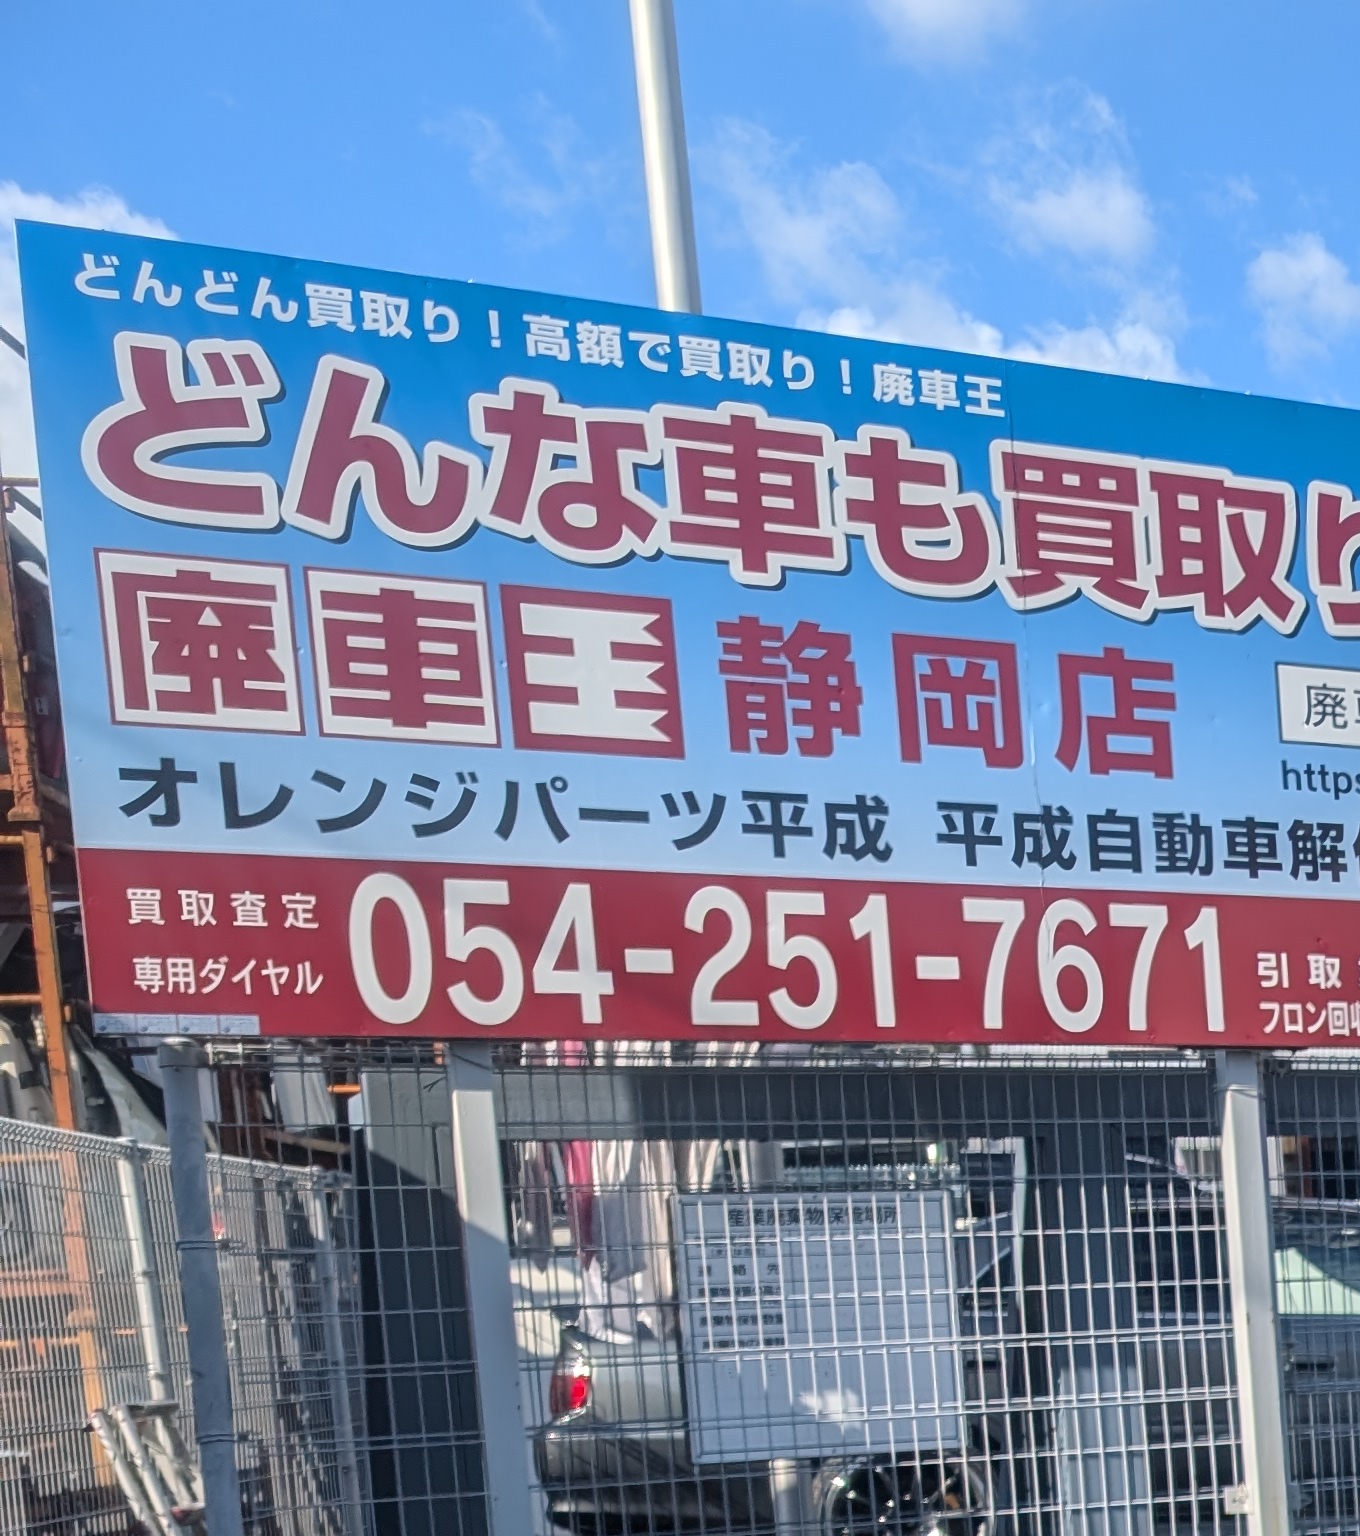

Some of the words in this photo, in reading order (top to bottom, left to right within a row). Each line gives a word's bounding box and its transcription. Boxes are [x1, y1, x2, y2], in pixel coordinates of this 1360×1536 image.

[118, 758, 894, 862] オレンジパーツ平成
[126, 887, 320, 929] 買取査定
[133, 956, 324, 996] 専用ダイヤル
[348, 870, 1226, 1032] 054-251-7671
